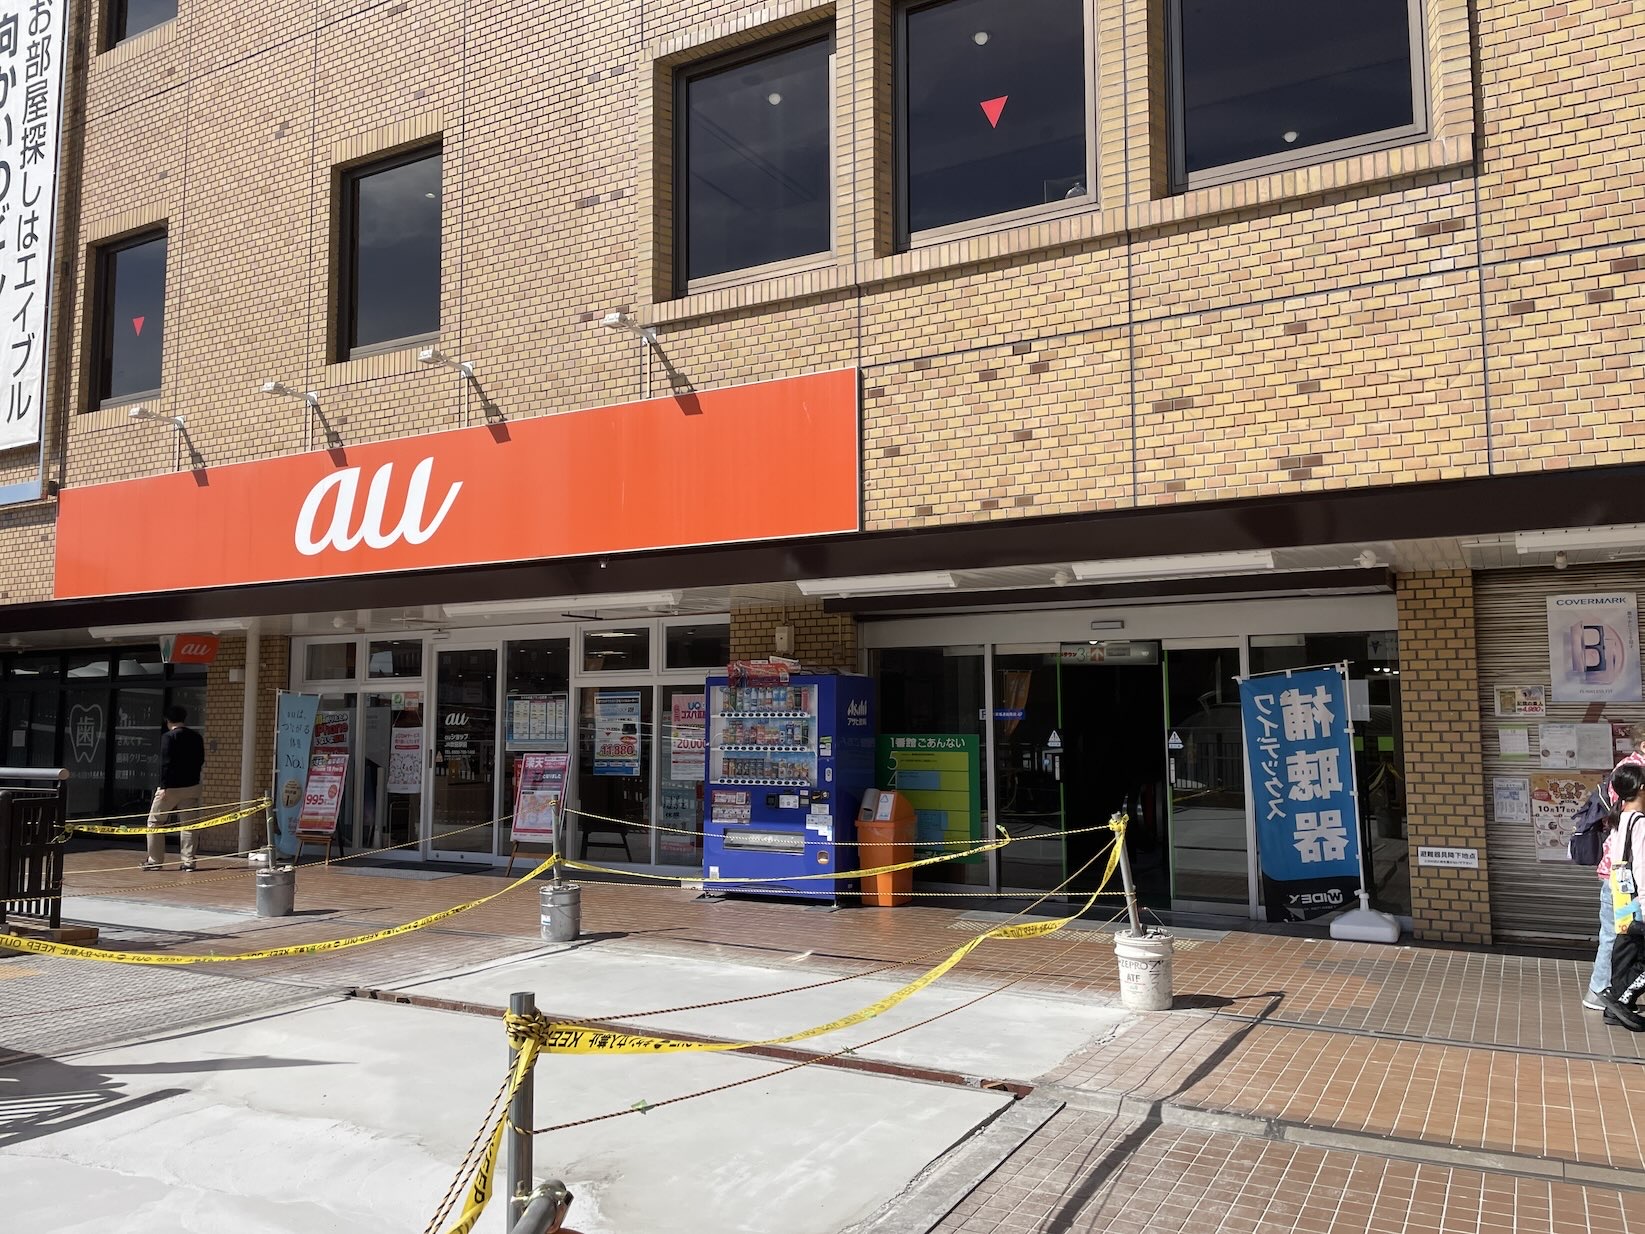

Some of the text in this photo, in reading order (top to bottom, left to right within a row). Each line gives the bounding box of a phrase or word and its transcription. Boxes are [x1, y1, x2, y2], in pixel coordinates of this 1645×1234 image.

[6, 0, 52, 424] お部屋探しはエイブル
[294, 456, 464, 556] au
[1556, 597, 1626, 606] COVERMARK
[180, 643, 212, 656] au
[847, 699, 867, 717] Asahi
[444, 712, 470, 726] au
[76, 715, 95, 747] 歯
[886, 750, 899, 771] 5
[886, 770, 898, 791] 4
[305, 794, 325, 805] 995
[1120, 959, 1149, 971] ZEPRO
[1126, 973, 1141, 983] ATF
